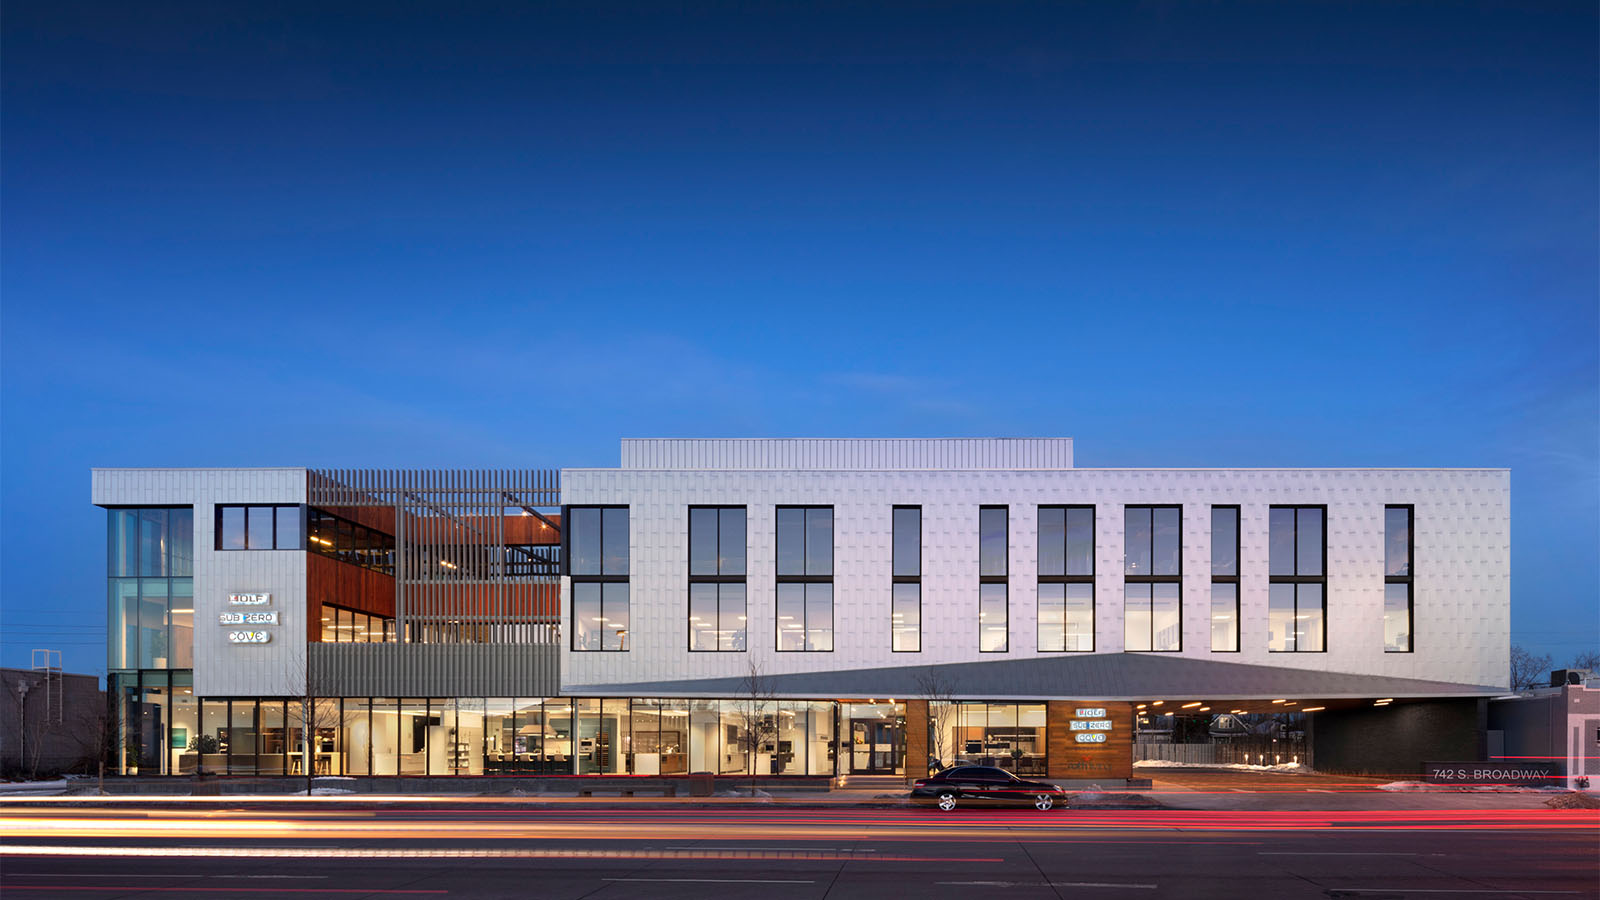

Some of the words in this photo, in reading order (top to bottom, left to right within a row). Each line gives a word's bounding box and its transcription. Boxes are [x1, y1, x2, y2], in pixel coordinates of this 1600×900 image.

[219, 614, 240, 622] SUB
[243, 614, 273, 622] ZERO
[229, 632, 263, 641] COVE
[1433, 769, 1454, 780] 742
[1457, 769, 1469, 780] S.
[1473, 769, 1549, 780] BROADWAY
